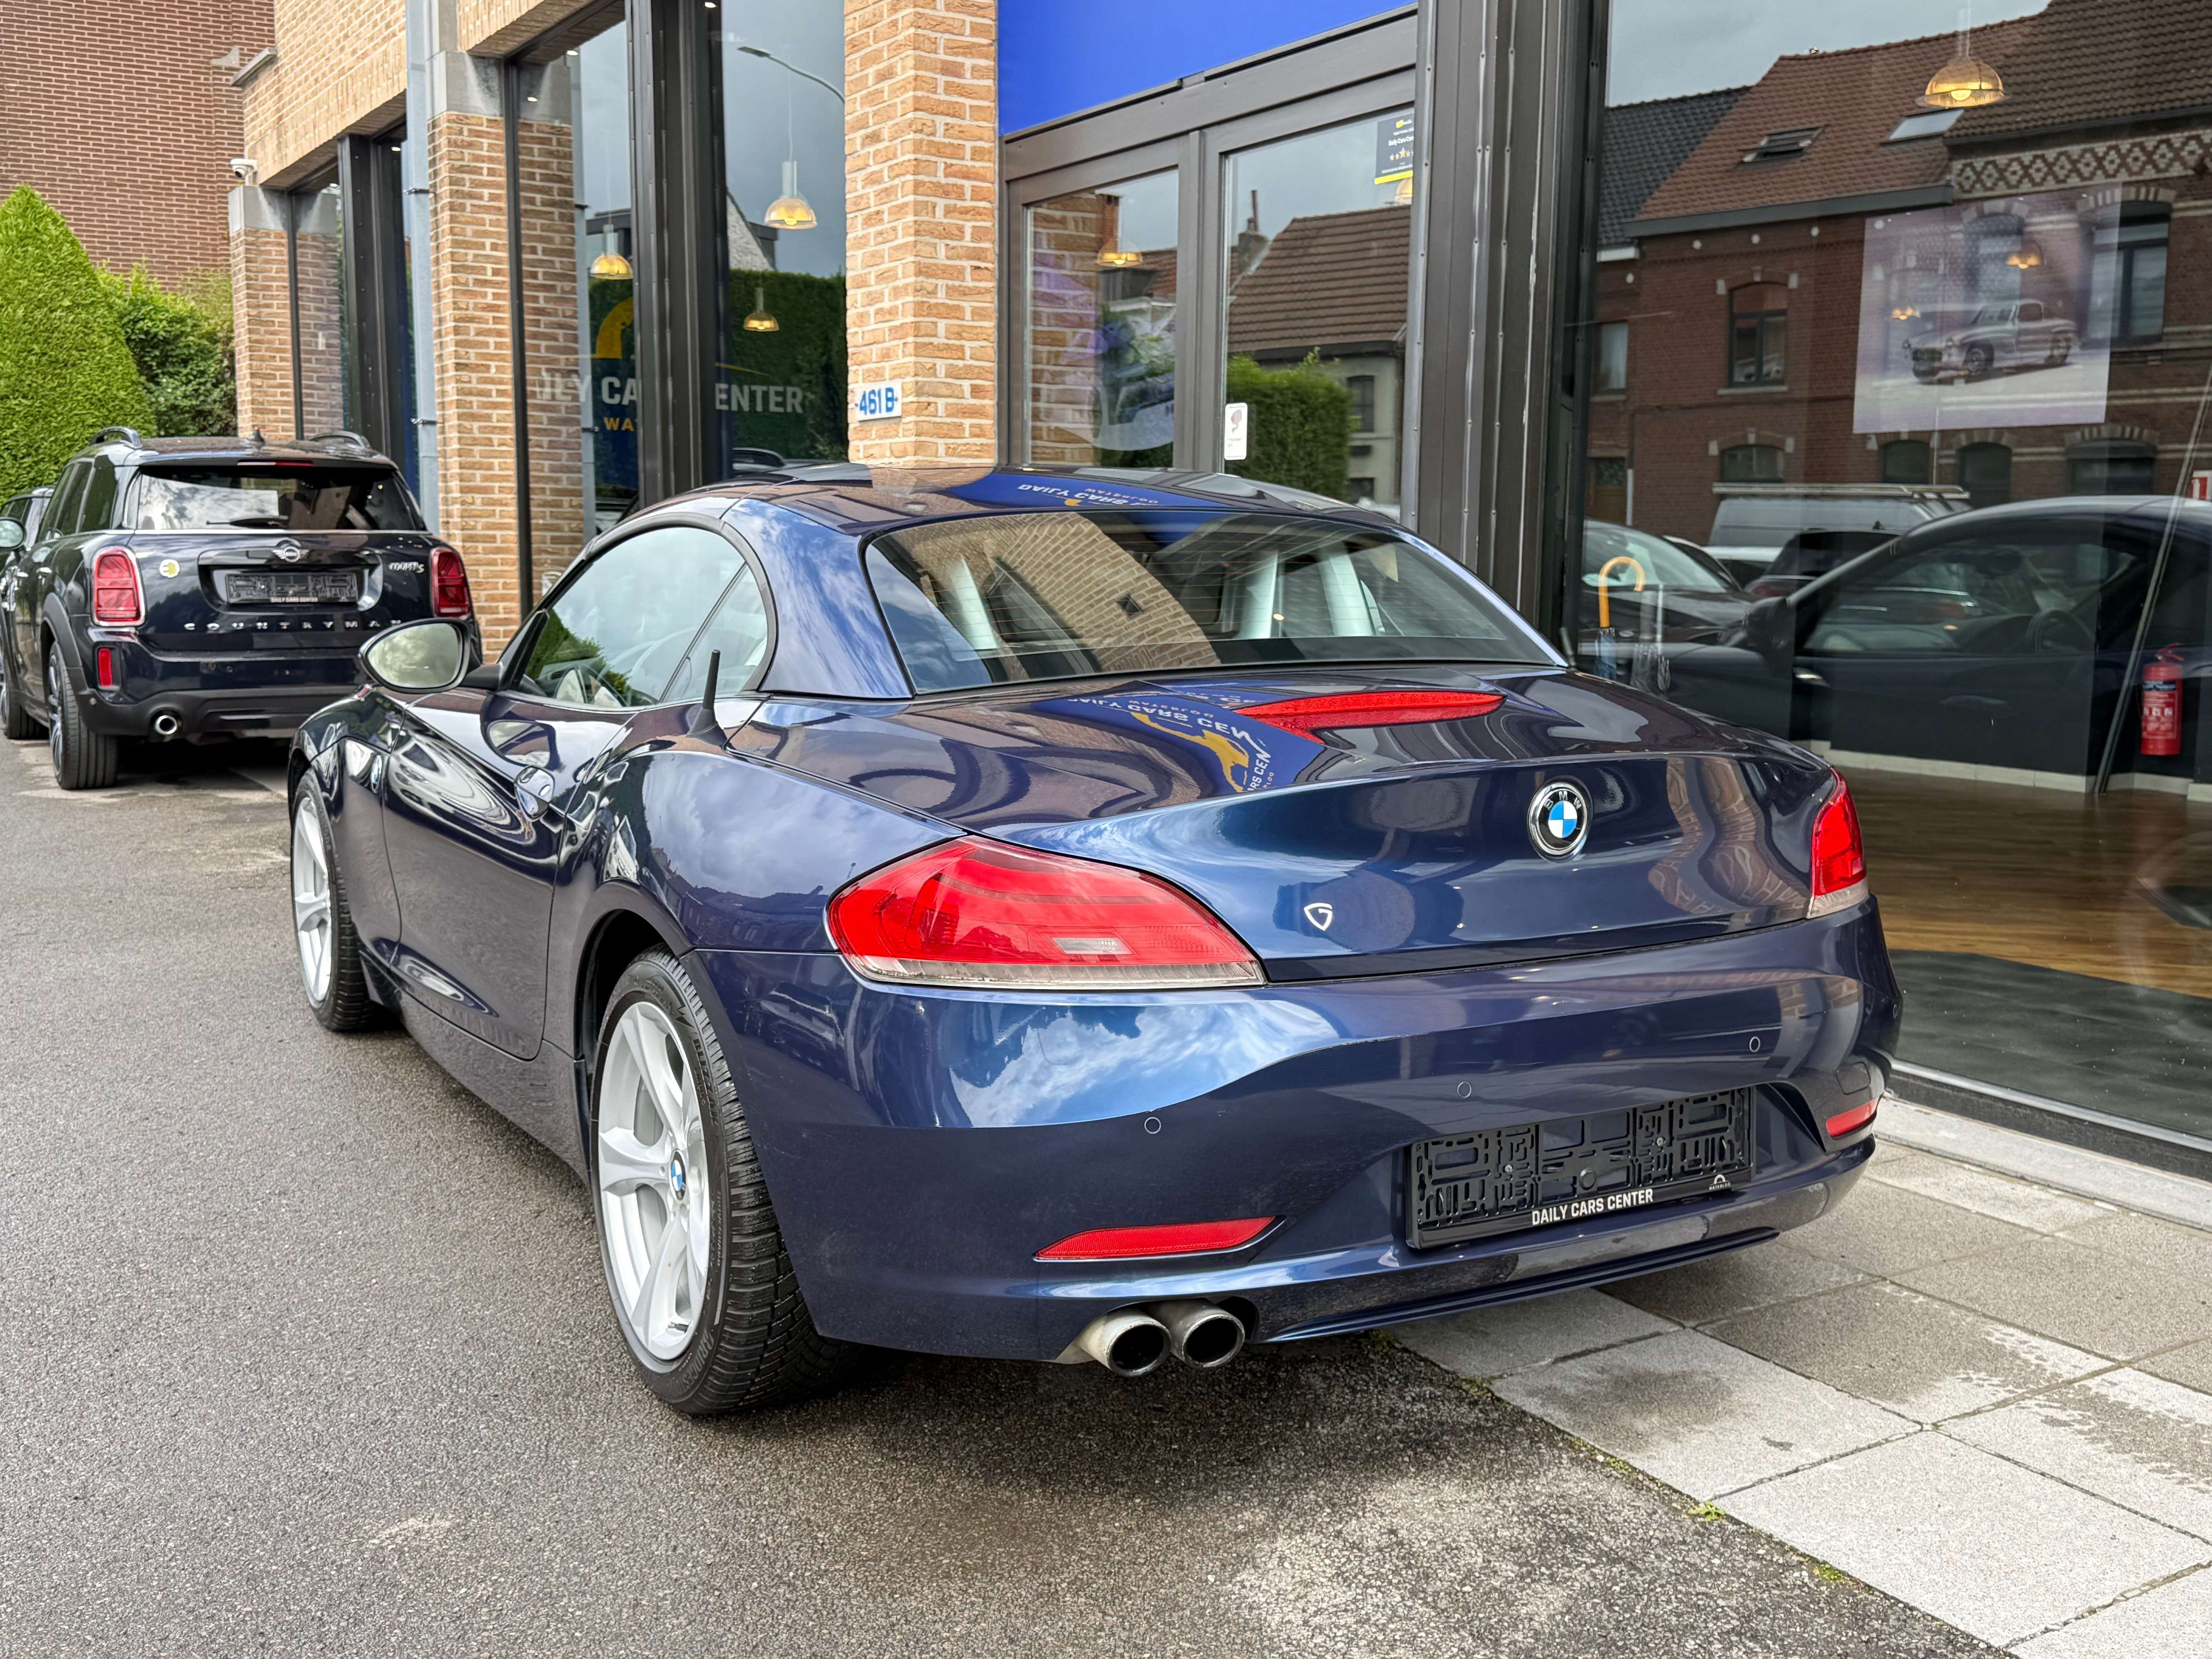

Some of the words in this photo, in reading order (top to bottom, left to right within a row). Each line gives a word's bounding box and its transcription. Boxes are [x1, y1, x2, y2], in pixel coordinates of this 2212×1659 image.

[601, 376, 642, 405] CA
[715, 383, 804, 413] ENTER
[604, 417, 635, 432] WA
[1544, 791, 1582, 811] BMW
[1532, 1204, 1568, 1225] DAILY
[1571, 1198, 1604, 1217] CARS
[1607, 1188, 1653, 1210] CENTER
